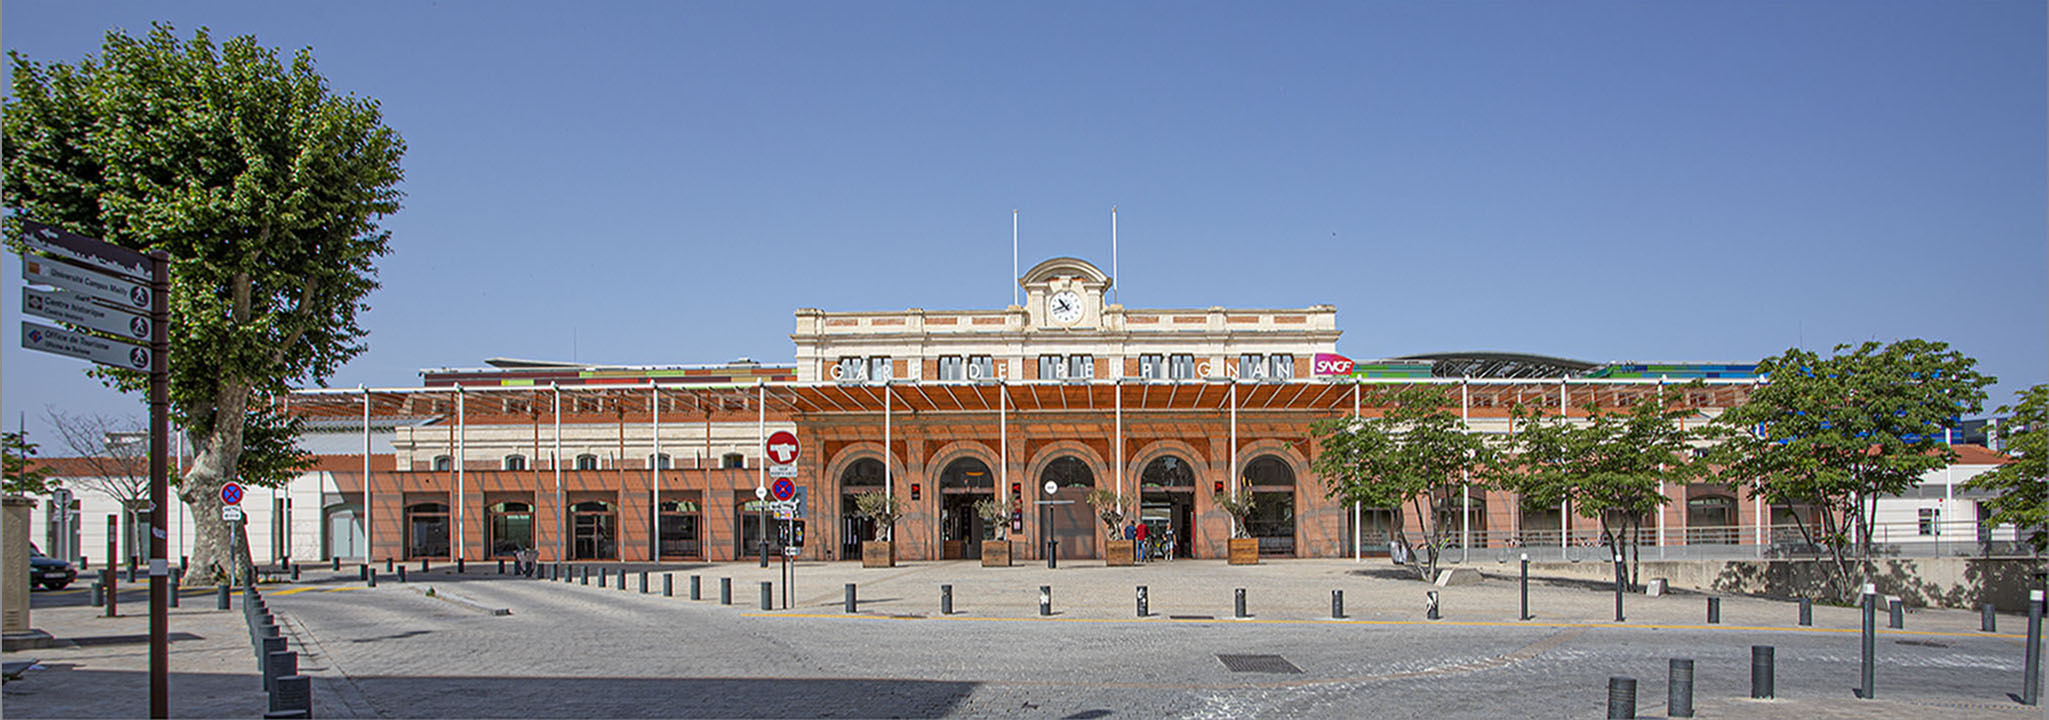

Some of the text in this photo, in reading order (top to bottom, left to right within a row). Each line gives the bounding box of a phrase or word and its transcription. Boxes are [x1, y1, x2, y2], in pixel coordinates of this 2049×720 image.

[830, 362, 1290, 380] GARE DE PERPIGNAN
[1316, 361, 1352, 373] SNCF
